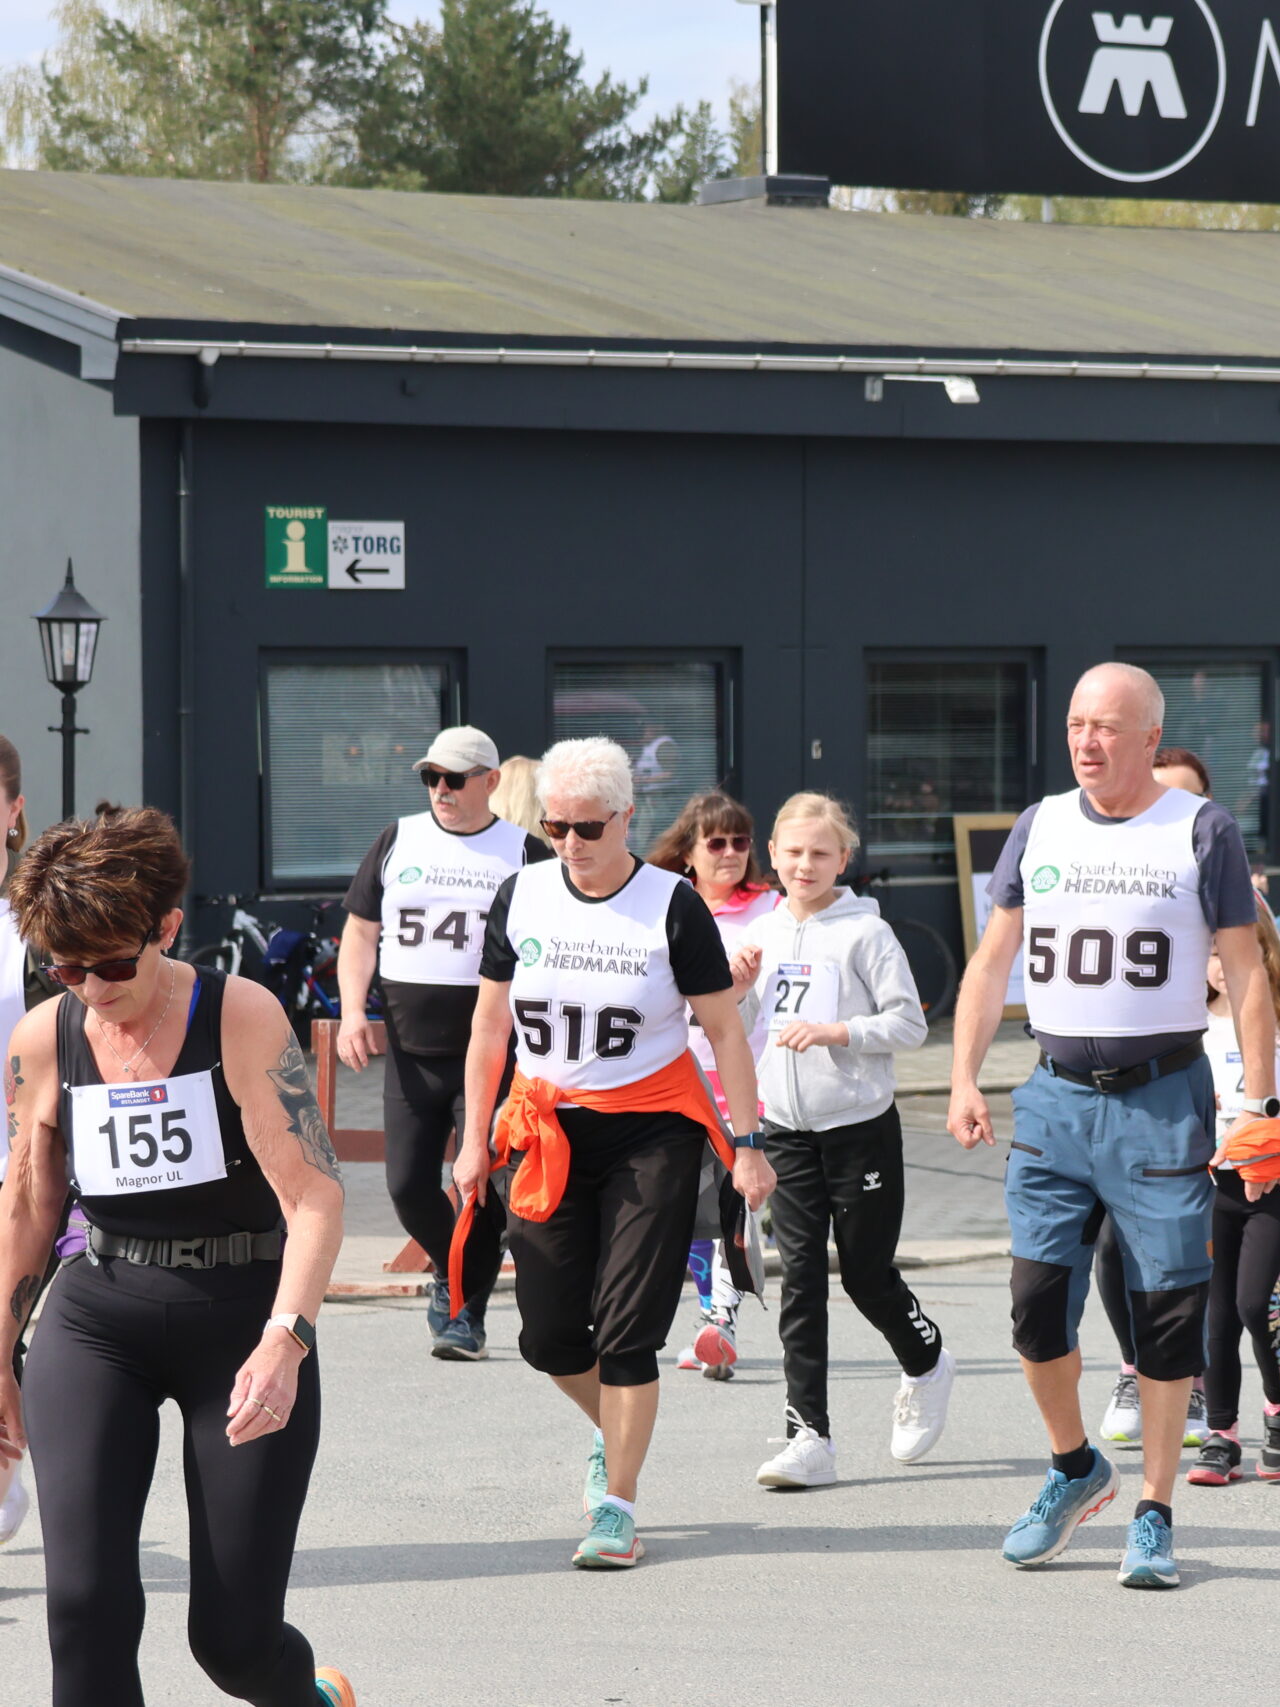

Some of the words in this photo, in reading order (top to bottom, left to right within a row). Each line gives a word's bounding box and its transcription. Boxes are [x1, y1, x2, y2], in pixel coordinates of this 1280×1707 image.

[267, 507, 325, 519] TOURIST
[352, 535, 401, 554] TORG
[1068, 861, 1177, 882] Sparebanken
[1064, 878, 1177, 899] HEDMARK
[547, 936, 648, 958] Sparebanken
[1029, 924, 1174, 991] 509
[544, 953, 648, 977] HEDMARK
[774, 979, 811, 1014] 27
[514, 996, 645, 1064] 516
[111, 1090, 150, 1100] SpareBank
[98, 1108, 193, 1169] 155
[116, 1174, 163, 1187] Magnor
[166, 1170, 183, 1182] UL
